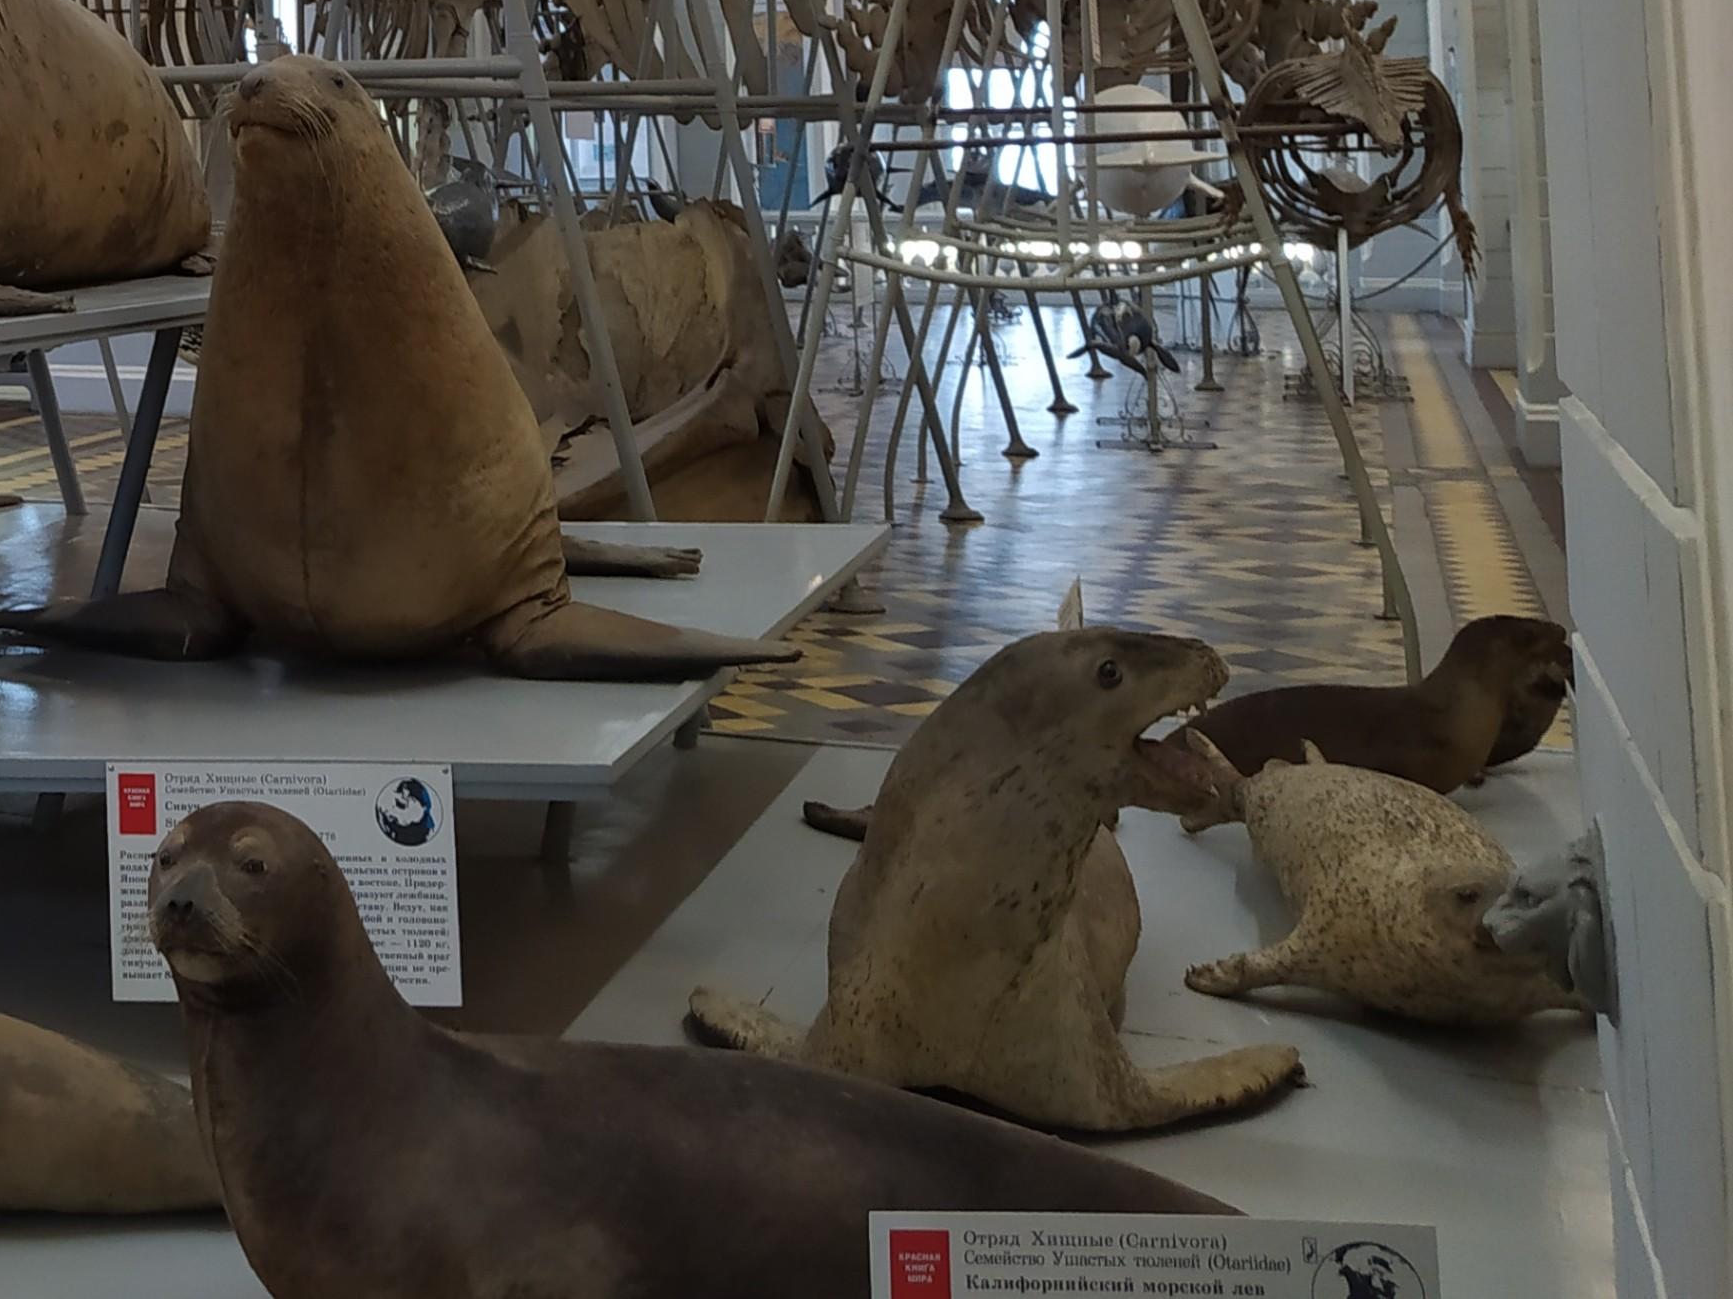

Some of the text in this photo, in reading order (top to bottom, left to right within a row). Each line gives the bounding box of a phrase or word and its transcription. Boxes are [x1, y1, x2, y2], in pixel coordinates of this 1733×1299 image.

[164, 773, 328, 786] Отряд Хищные (Carnivora)
[164, 785, 367, 797] Семейство Ушастых тюленей (Otariidae)
[164, 800, 201, 814] Сивуч
[319, 832, 337, 842] 776
[391, 868, 438, 879] островов
[407, 940, 432, 949] 1120
[963, 1230, 1228, 1251] Отряд Хищные (Carnivora)
[898, 1252, 941, 1262] КРАСНАЯ
[963, 1250, 1291, 1275] Семейство Ушастых тюленей (Otariidae)
[904, 1263, 936, 1273] КНИГА
[907, 1273, 933, 1284] МИРА
[965, 1274, 1267, 1297] Калифорнийский морской лев
